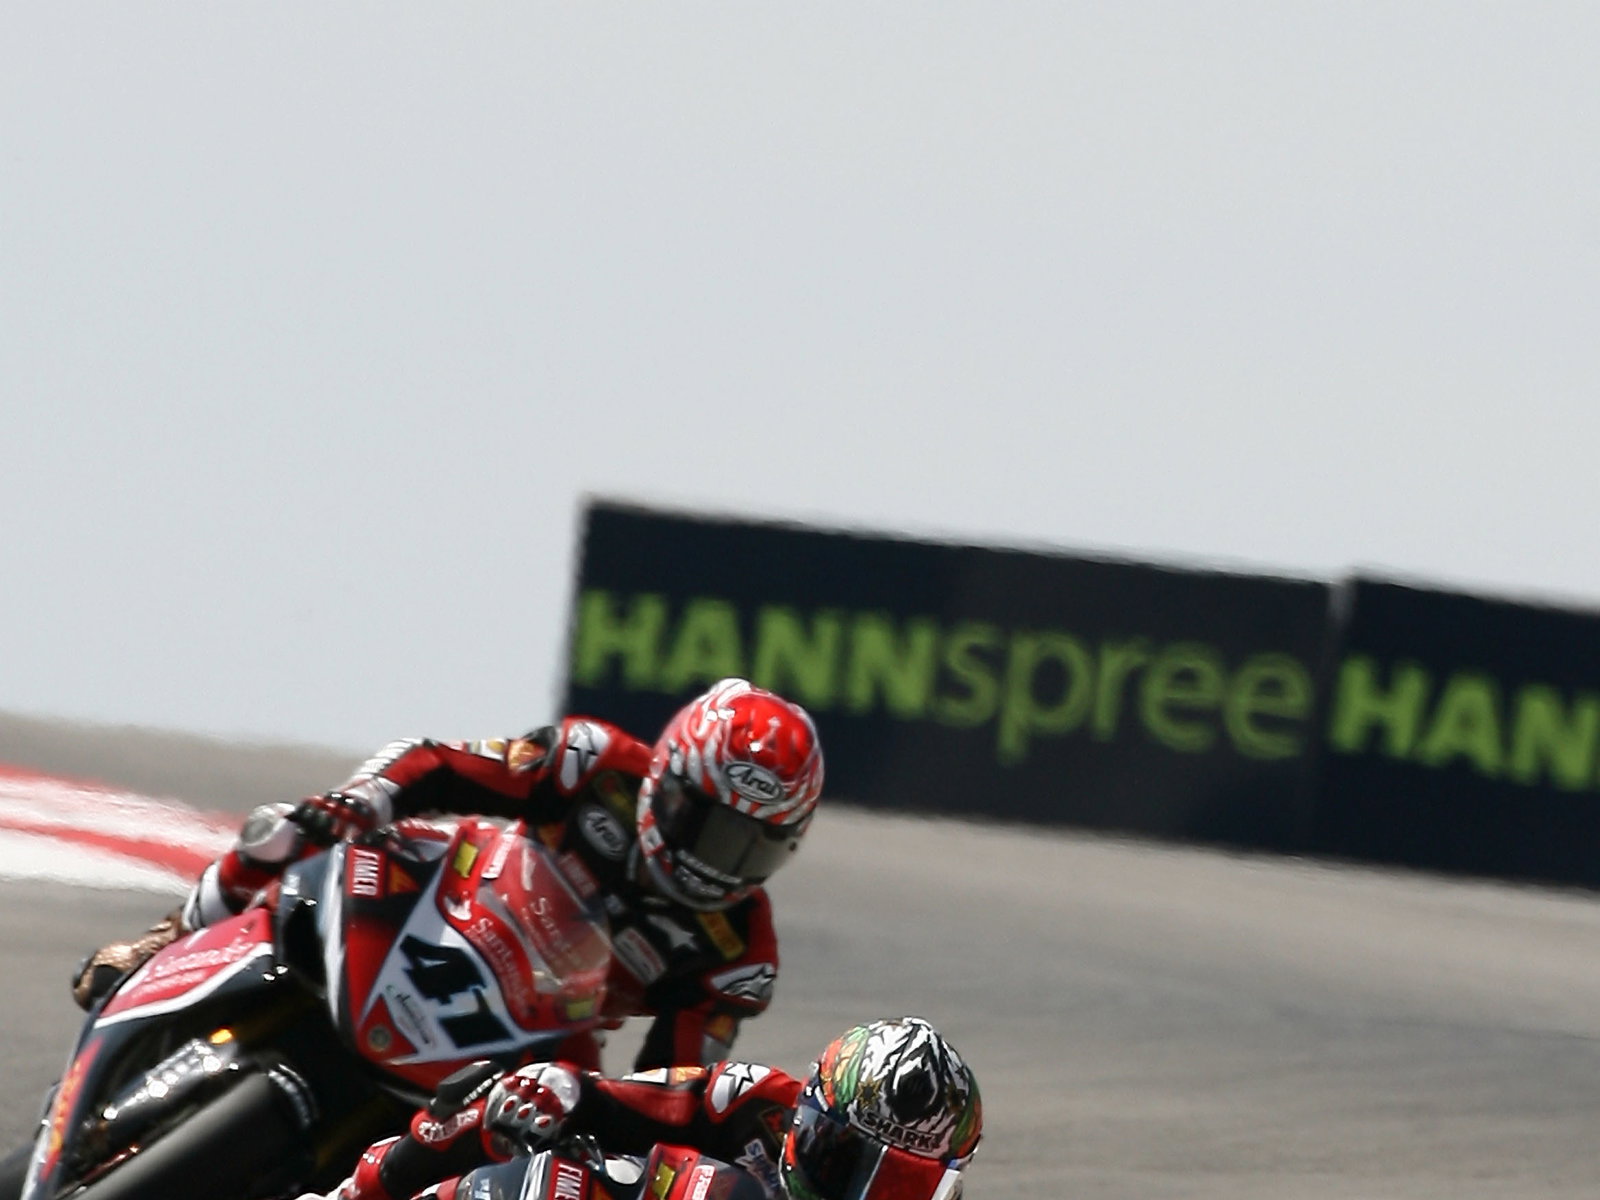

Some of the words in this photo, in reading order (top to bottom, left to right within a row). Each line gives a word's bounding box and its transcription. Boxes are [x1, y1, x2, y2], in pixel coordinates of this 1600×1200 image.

[571, 588, 1316, 765] HANNspree
[1330, 648, 1600, 792] HAN
[729, 766, 775, 797] Arai
[400, 934, 516, 1050] 41
[862, 1110, 940, 1150] SHARK
